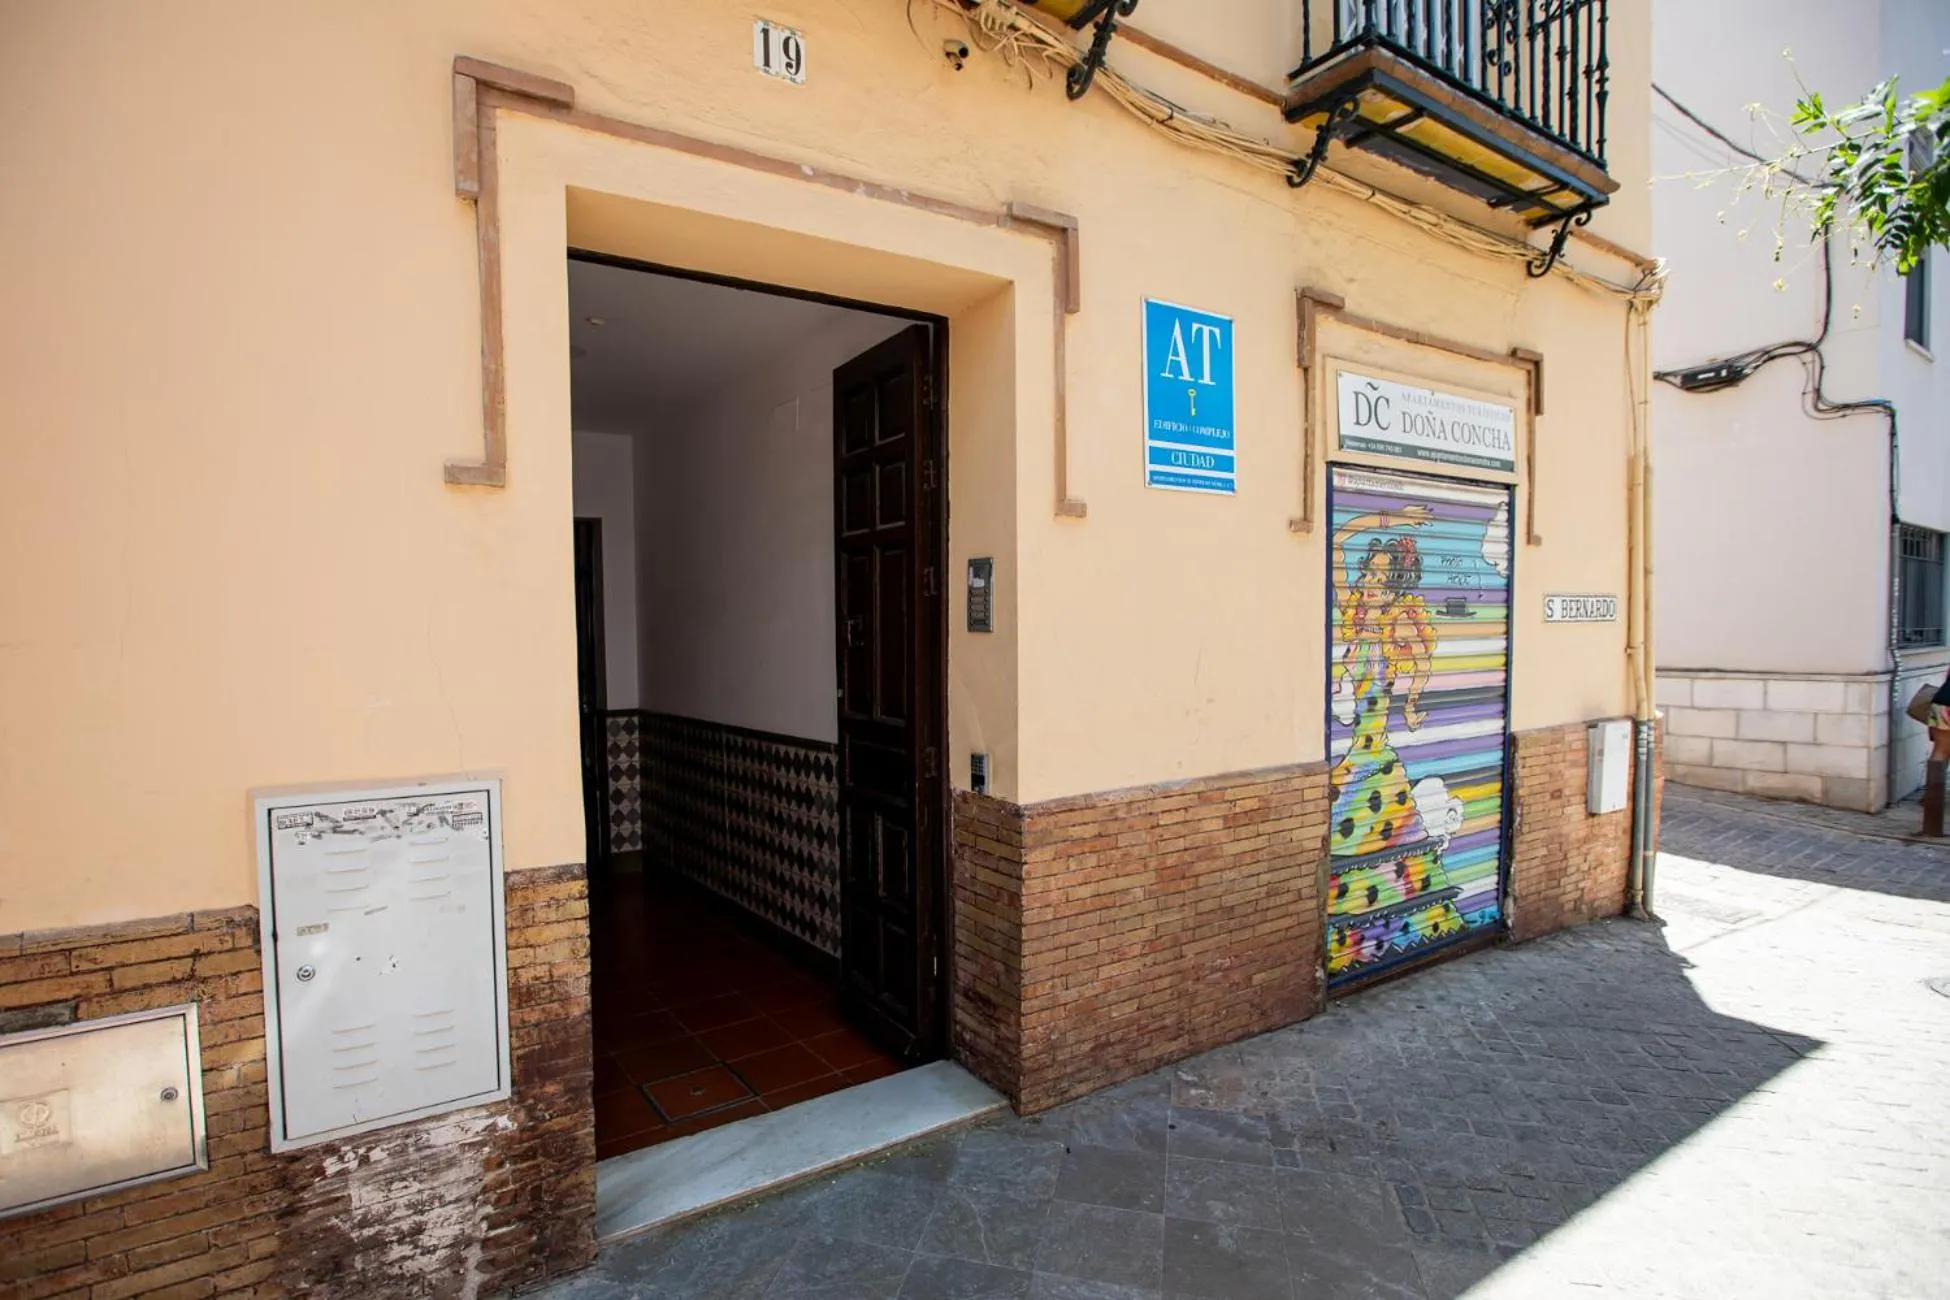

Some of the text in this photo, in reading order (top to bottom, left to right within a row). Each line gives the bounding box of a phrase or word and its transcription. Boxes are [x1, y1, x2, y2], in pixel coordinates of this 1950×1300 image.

[760, 27, 802, 76] 19
[1160, 316, 1222, 386] AT
[1402, 410, 1512, 452] DOÑA CONCHA
[1171, 451, 1215, 468] CIUDAD
[1561, 598, 1616, 618] BERNARDO
